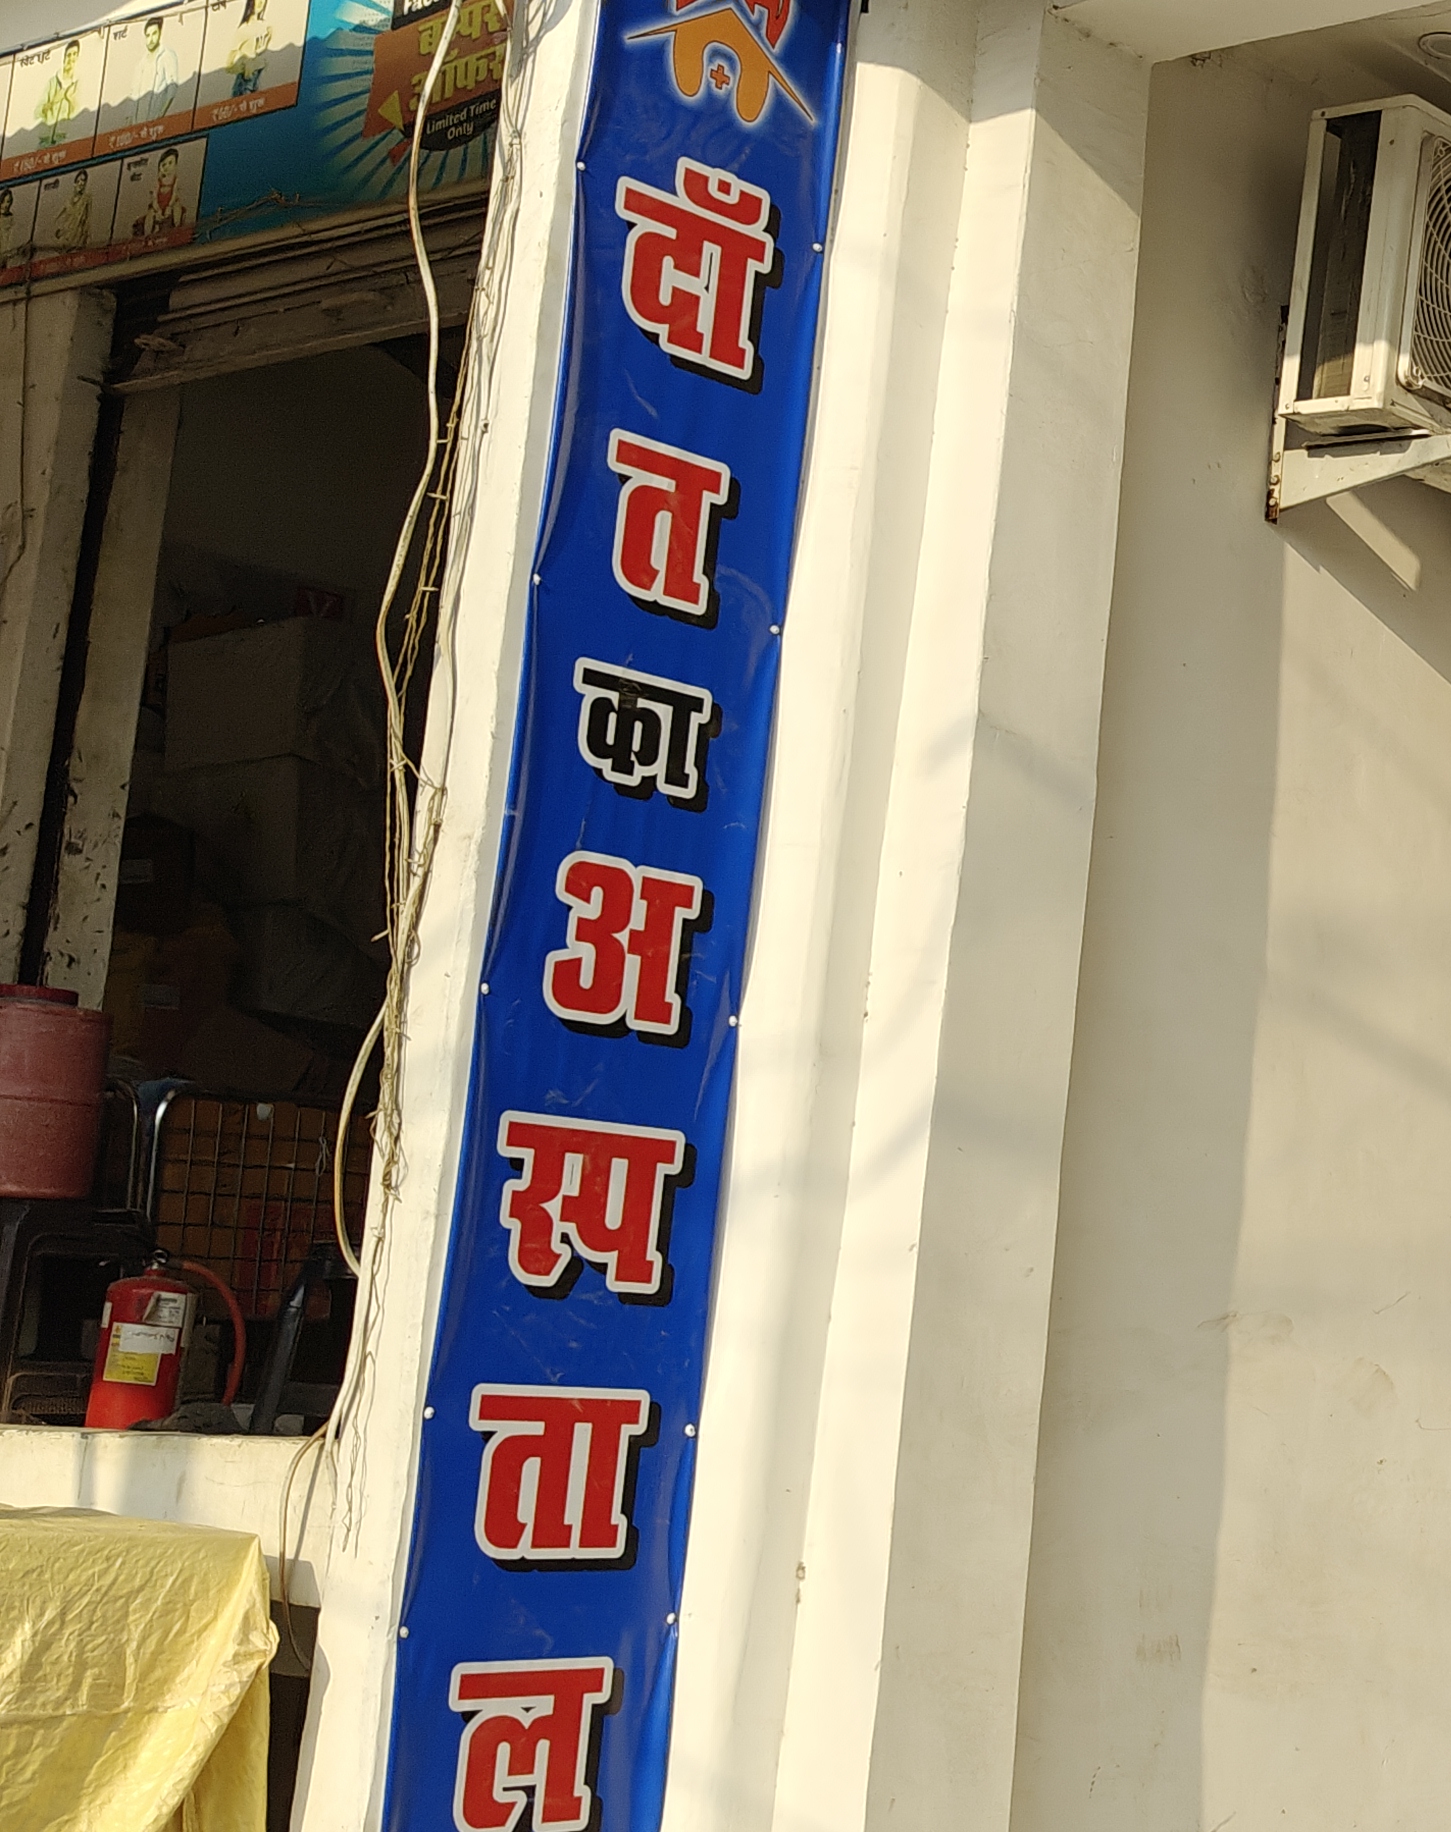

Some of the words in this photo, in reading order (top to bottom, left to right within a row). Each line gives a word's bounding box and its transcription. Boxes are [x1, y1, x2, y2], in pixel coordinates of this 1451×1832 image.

[418, 1, 501, 55] बपर
[426, 111, 467, 134] Limited
[469, 99, 496, 118] Time
[447, 121, 474, 140] Only
